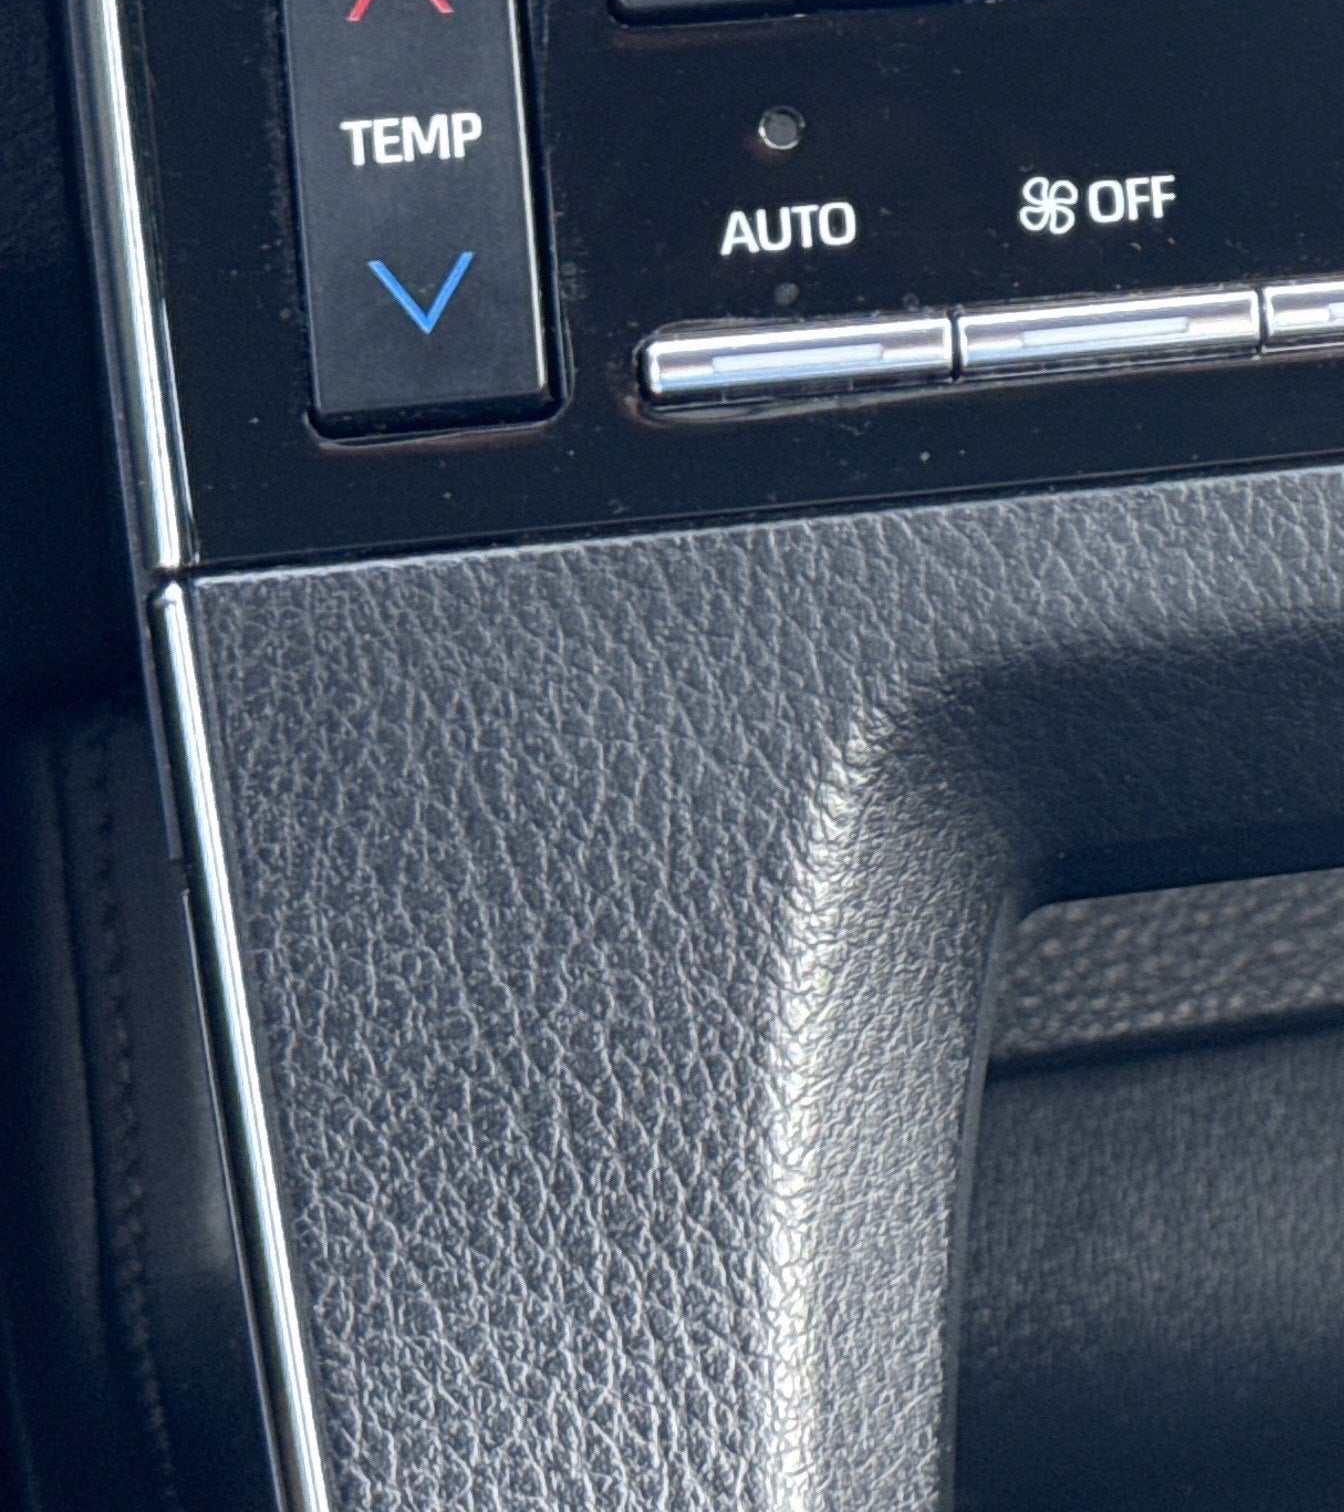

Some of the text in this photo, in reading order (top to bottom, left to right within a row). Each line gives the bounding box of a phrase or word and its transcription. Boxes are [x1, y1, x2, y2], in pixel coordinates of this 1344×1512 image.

[340, 112, 483, 166] TEMP
[1087, 175, 1178, 221] OFF
[719, 201, 857, 256] AUTO
